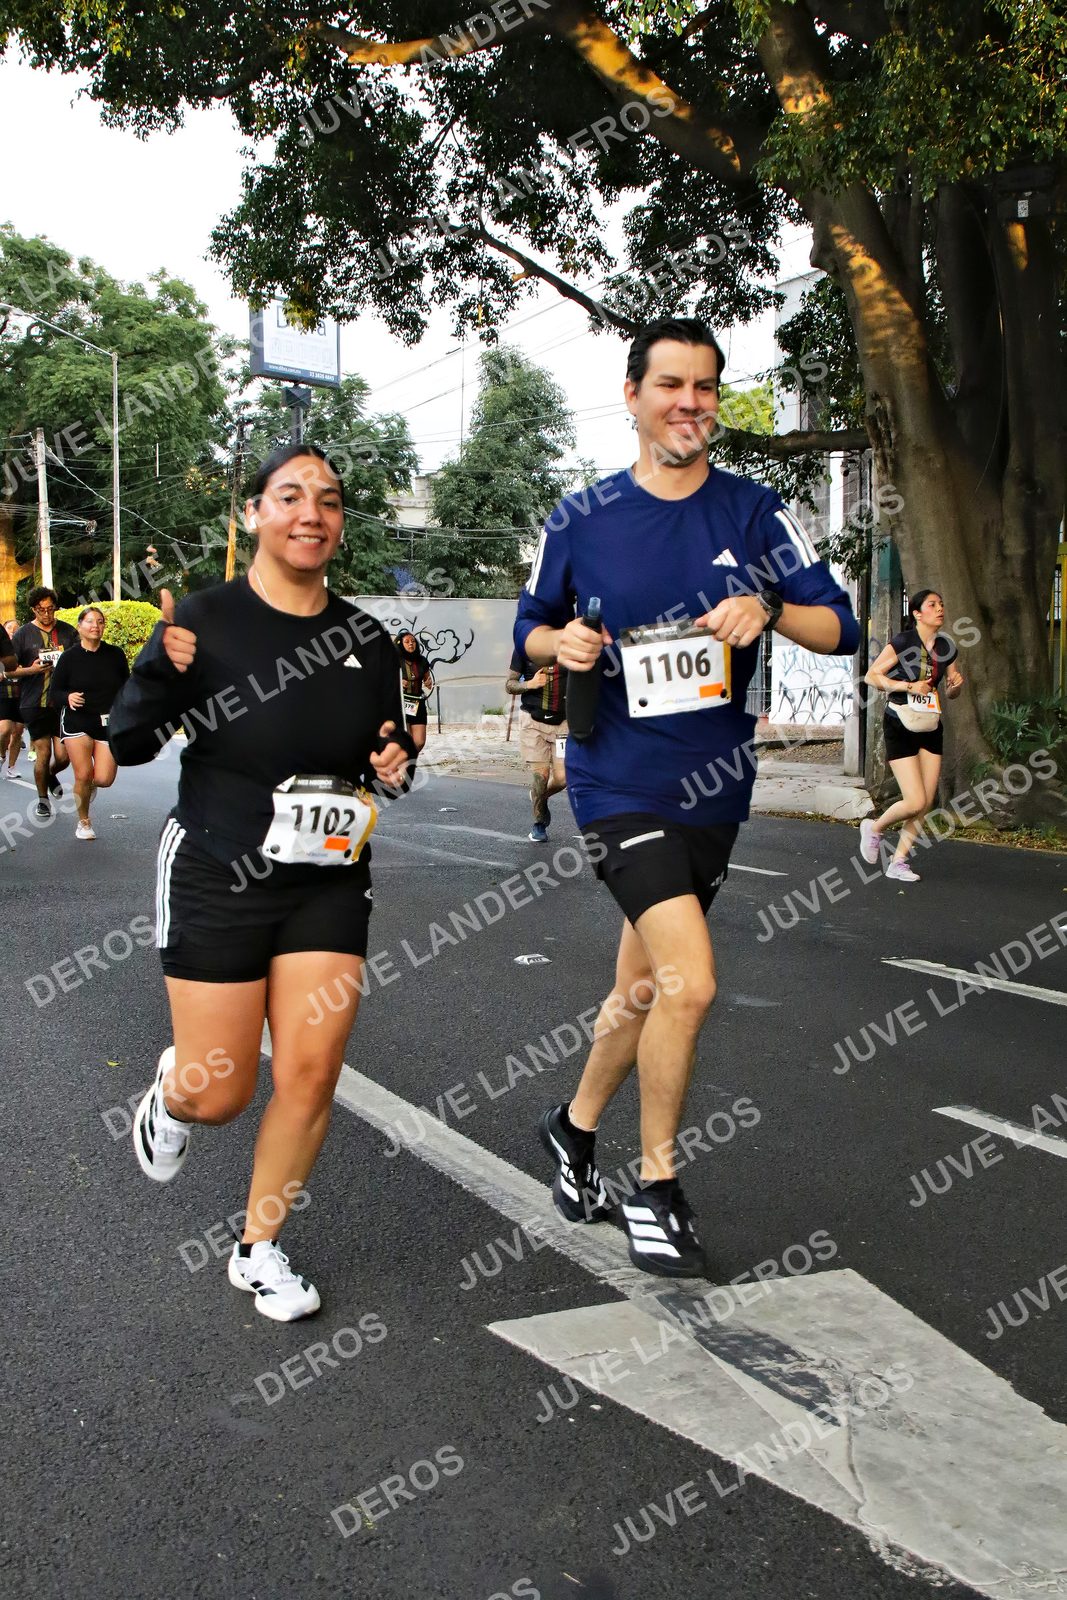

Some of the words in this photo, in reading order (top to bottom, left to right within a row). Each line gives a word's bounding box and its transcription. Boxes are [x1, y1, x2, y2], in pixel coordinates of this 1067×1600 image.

[639, 647, 712, 684] 1106
[911, 694, 931, 704] 7057
[291, 804, 356, 836] 1102
